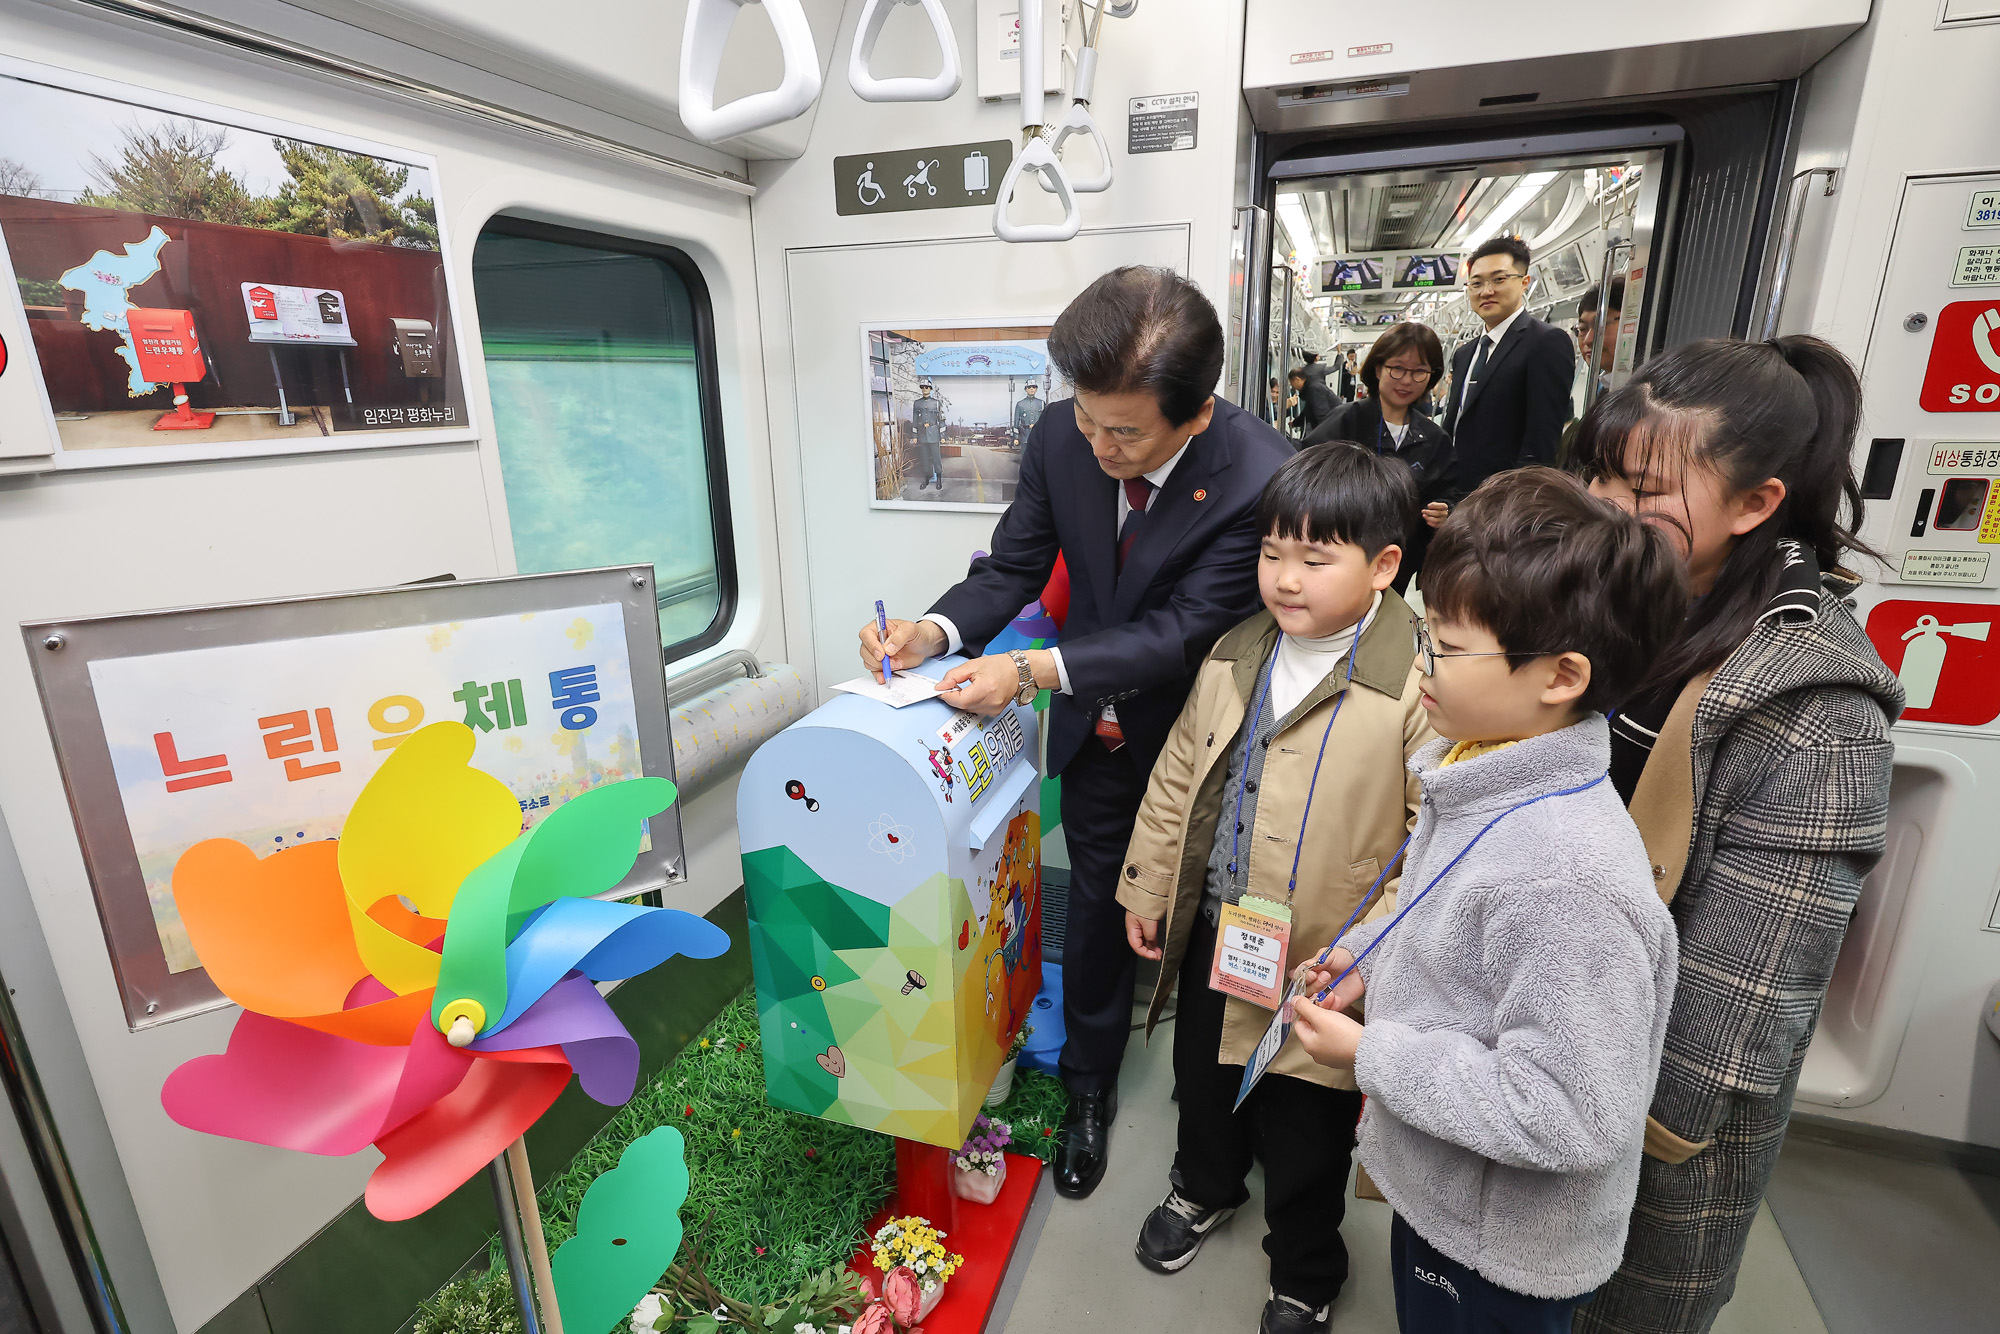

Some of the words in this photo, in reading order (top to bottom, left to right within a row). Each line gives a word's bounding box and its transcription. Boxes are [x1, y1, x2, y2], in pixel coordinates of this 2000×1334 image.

[1152, 98, 1167, 106] CCTV
[1169, 96, 1181, 104] 설치
[1183, 95, 1195, 104] 안내
[1967, 257, 1991, 265] 알리고
[364, 408, 404, 425] 임진각
[407, 407, 456, 423] 평화누리
[1243, 942, 1260, 953] 출연자
[1228, 962, 1239, 970] 버스
[1415, 1266, 1436, 1281] FLC
